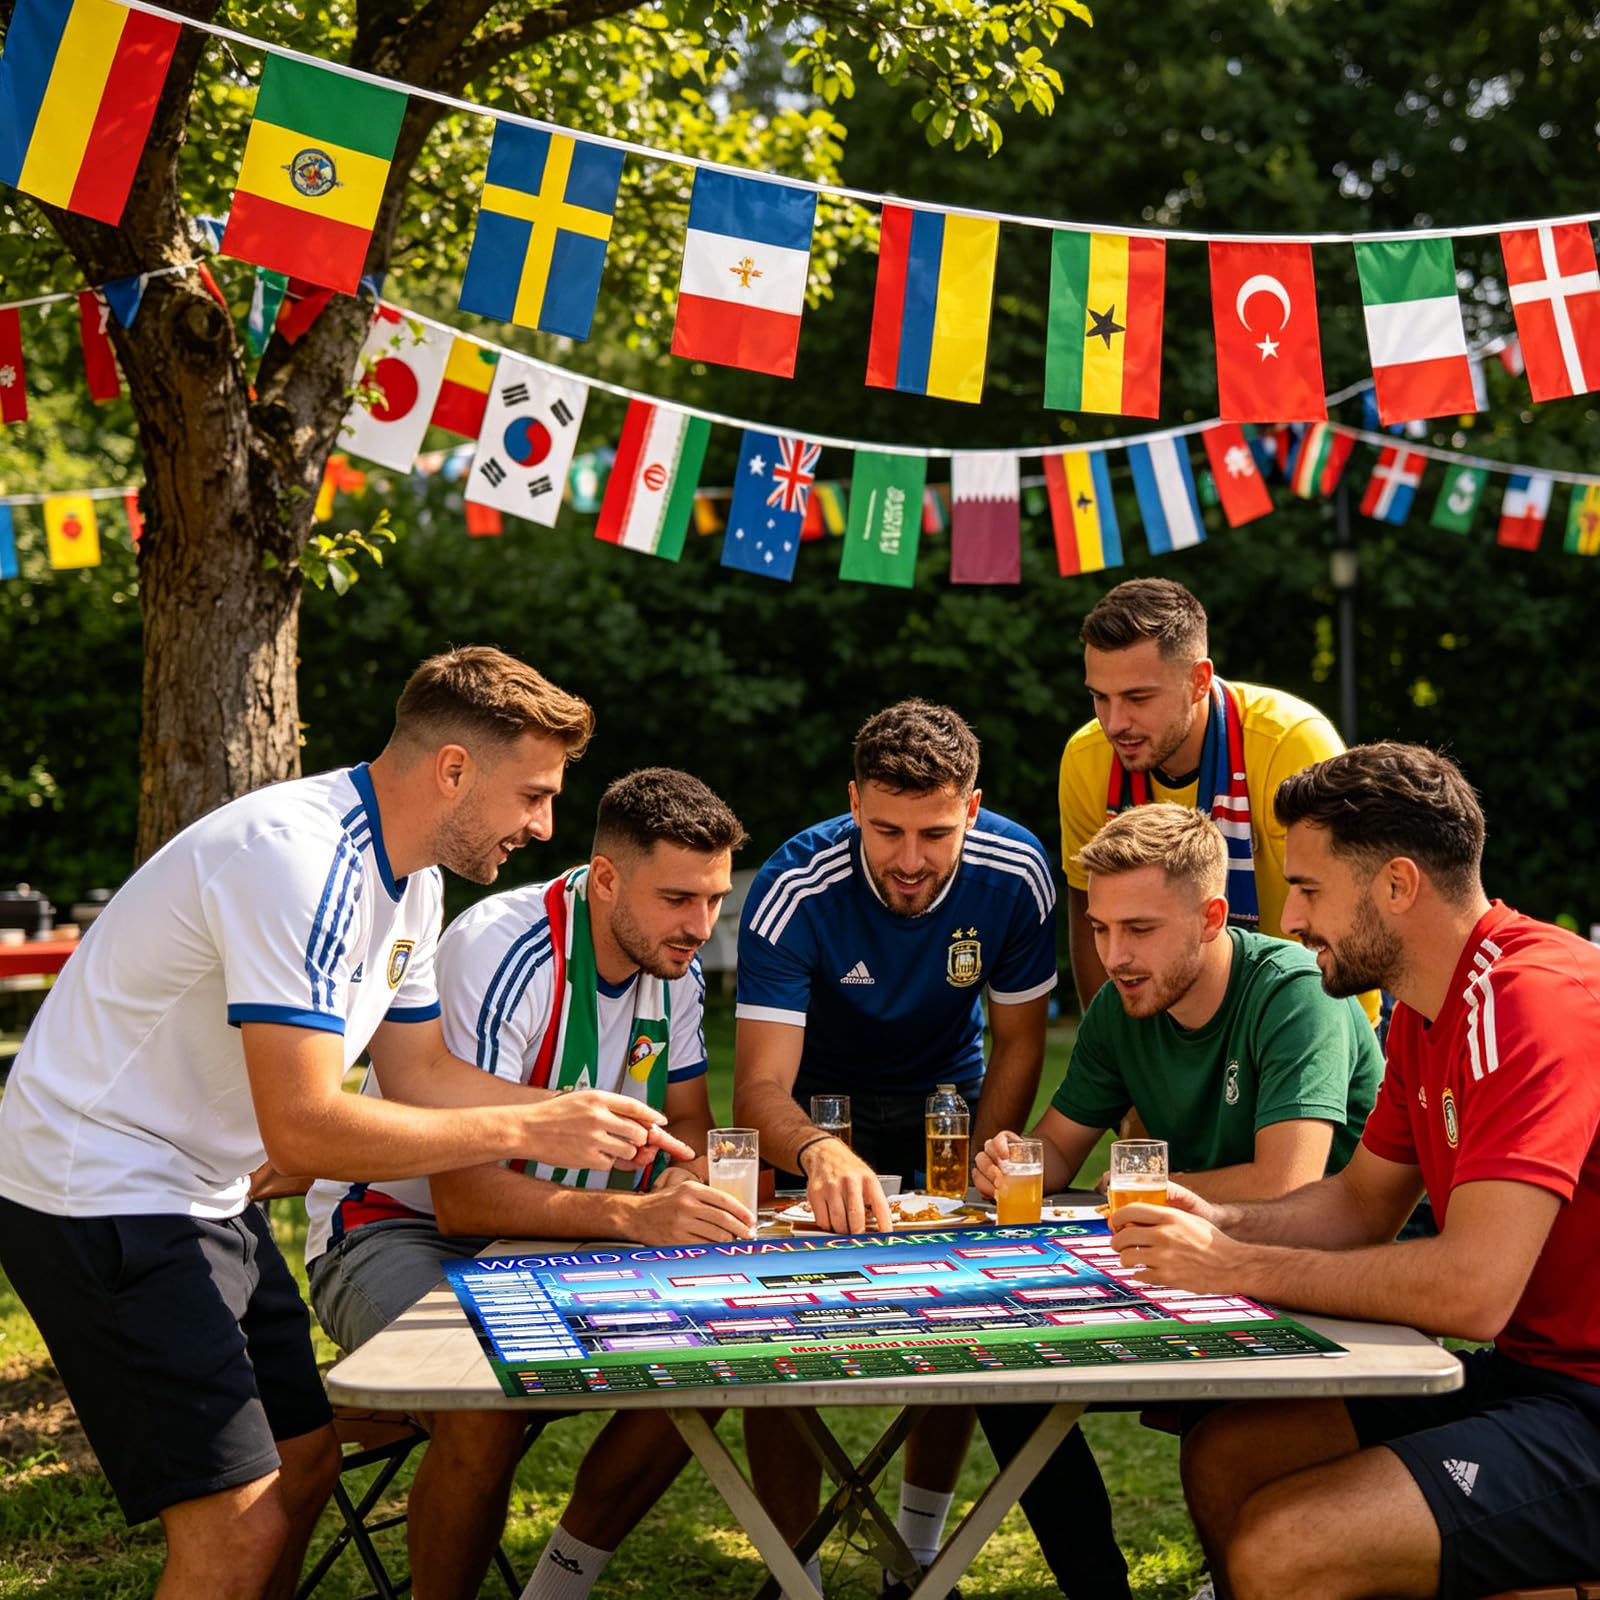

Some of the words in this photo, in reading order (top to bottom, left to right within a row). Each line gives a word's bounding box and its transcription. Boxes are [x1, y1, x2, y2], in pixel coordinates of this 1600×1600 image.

[477, 1252, 622, 1272] WORLD
[629, 1247, 708, 1262] CUP
[715, 1232, 956, 1255] WALLCHART
[790, 1344, 844, 1354] Men's
[845, 1340, 900, 1350] World
[901, 1336, 978, 1347] Ranking
